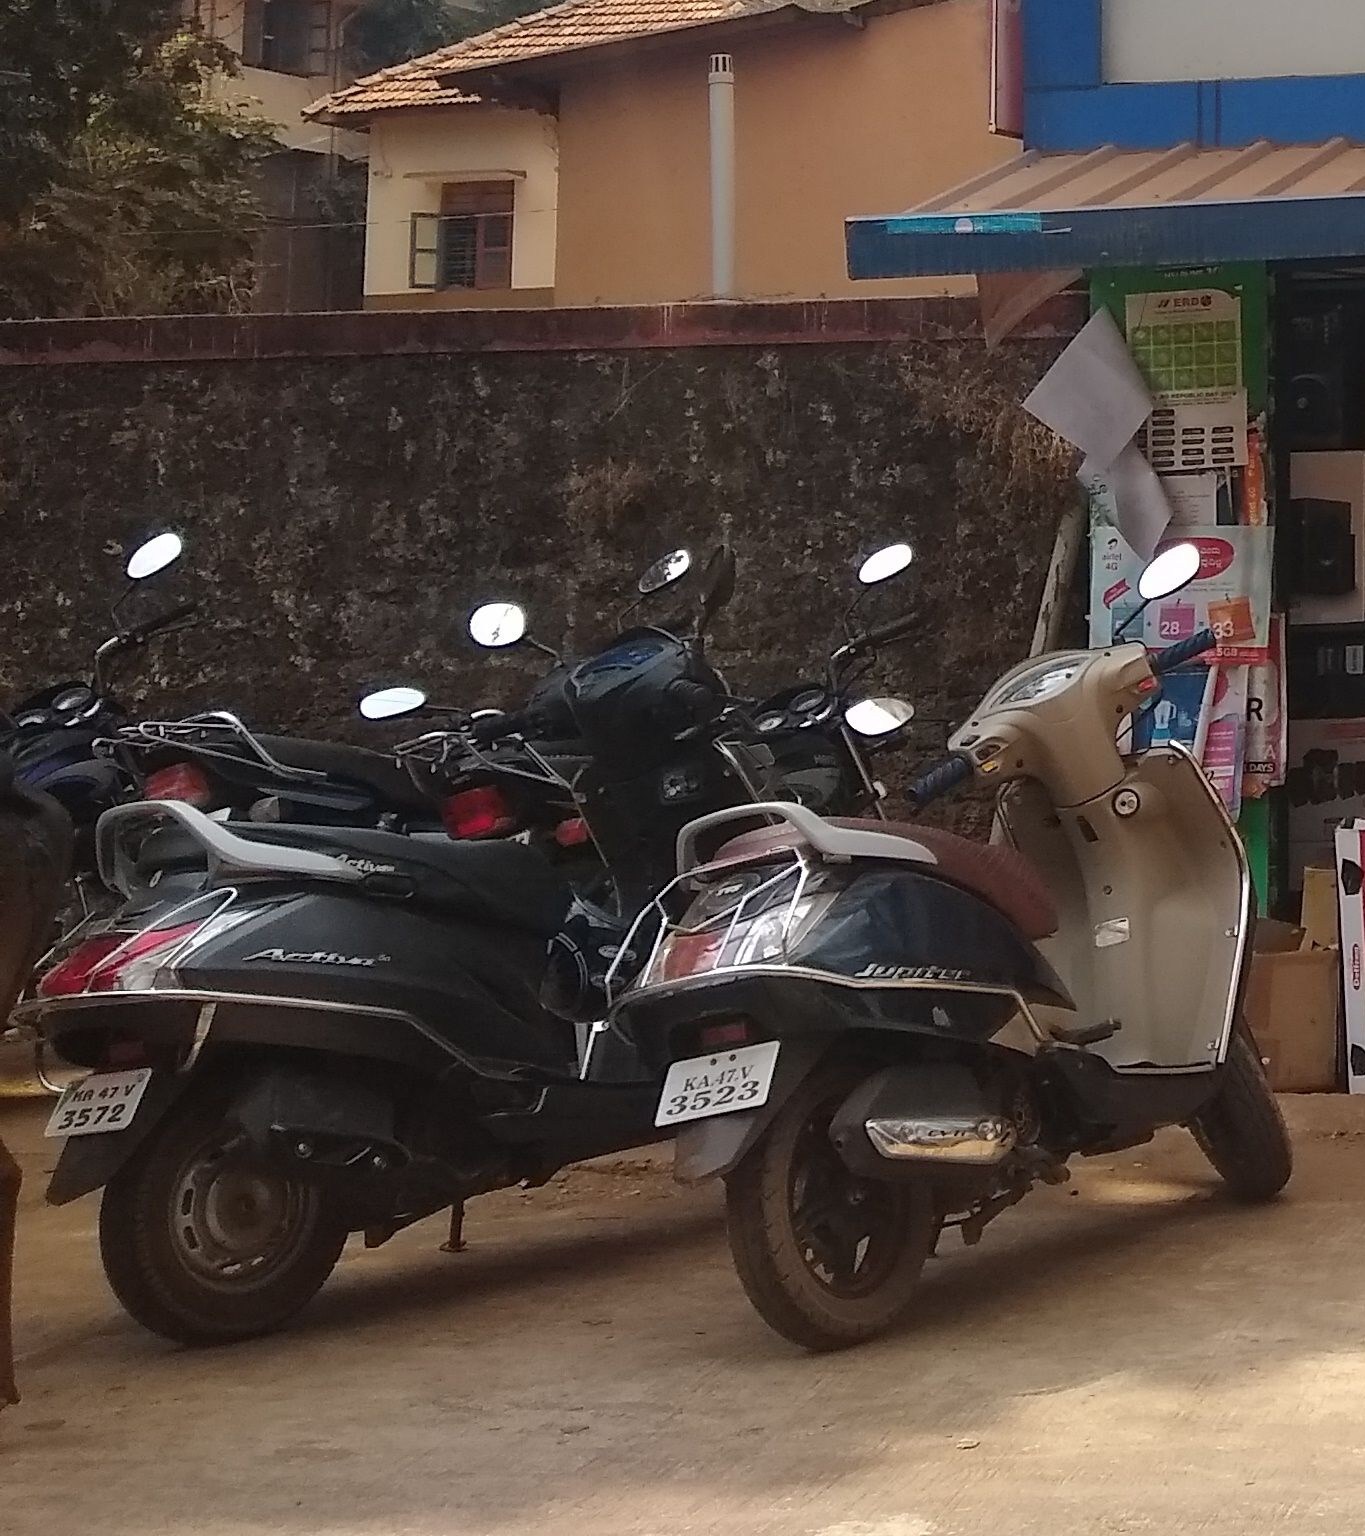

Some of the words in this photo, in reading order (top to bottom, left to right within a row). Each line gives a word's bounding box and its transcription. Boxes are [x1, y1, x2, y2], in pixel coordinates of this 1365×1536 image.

[1102, 552, 1122, 562] airtel
[1105, 562, 1119, 572] 4G
[1160, 621, 1180, 636] 28
[1212, 621, 1234, 638] 33
[1249, 763, 1274, 773] DAYS
[242, 948, 376, 967] Activa
[854, 962, 971, 981] Jupiter
[73, 1089, 94, 1102] KA
[98, 1086, 119, 1099] 47
[124, 1083, 136, 1097] V
[666, 1080, 760, 1116] 3523
[57, 1103, 126, 1130] 3572
